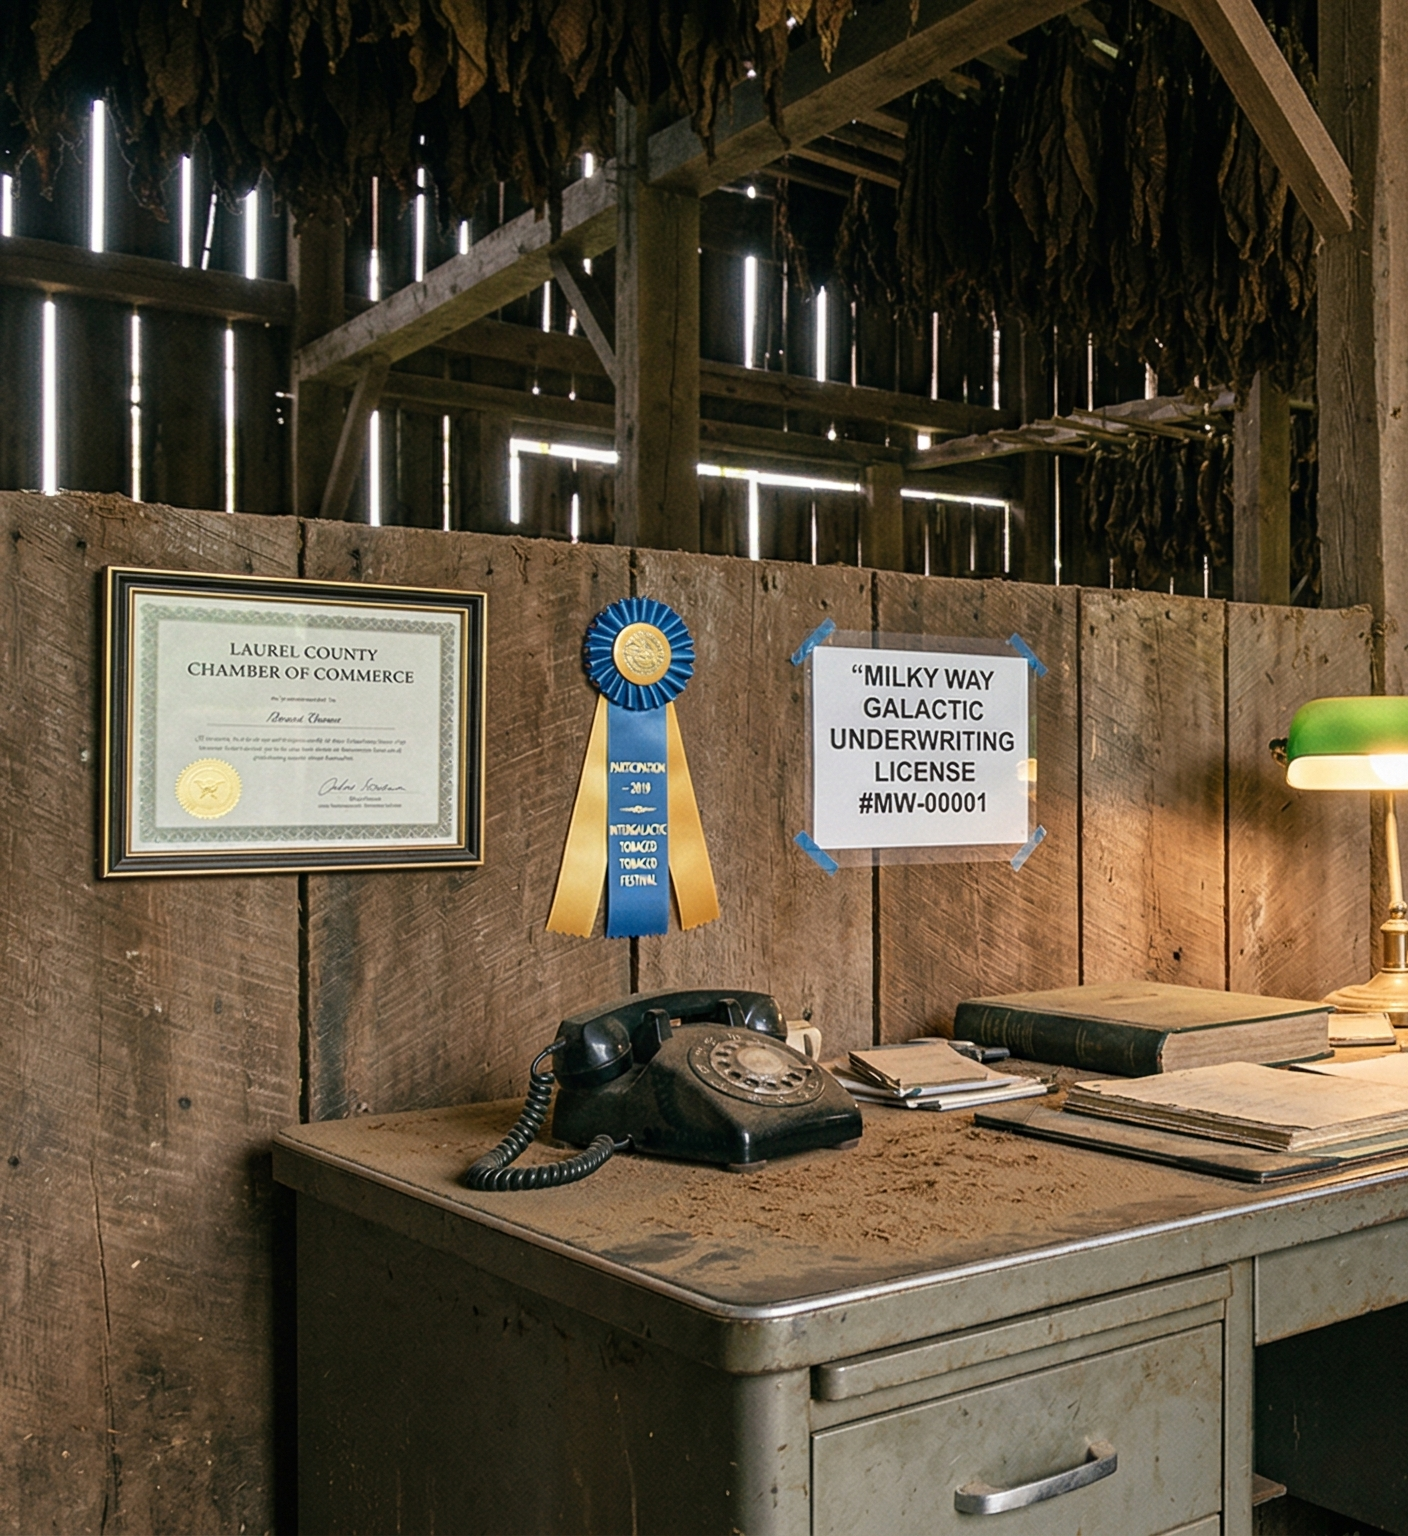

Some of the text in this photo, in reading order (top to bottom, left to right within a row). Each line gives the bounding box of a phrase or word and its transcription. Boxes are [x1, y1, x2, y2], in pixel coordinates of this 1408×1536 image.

[229, 642, 378, 662] LAUREL COUNTY
[187, 661, 415, 684] CHAMBER OF COMMERCE
[944, 668, 994, 690] WAY
[863, 697, 984, 721] GALACTIC
[830, 728, 1015, 752] UNDERWRITING
[875, 761, 976, 782] LICENSE
[858, 792, 986, 814] #MW-00001
[619, 840, 658, 853] TOBACCO
[619, 857, 658, 870] TOBACCO
[619, 873, 658, 887] FESTIVAL
